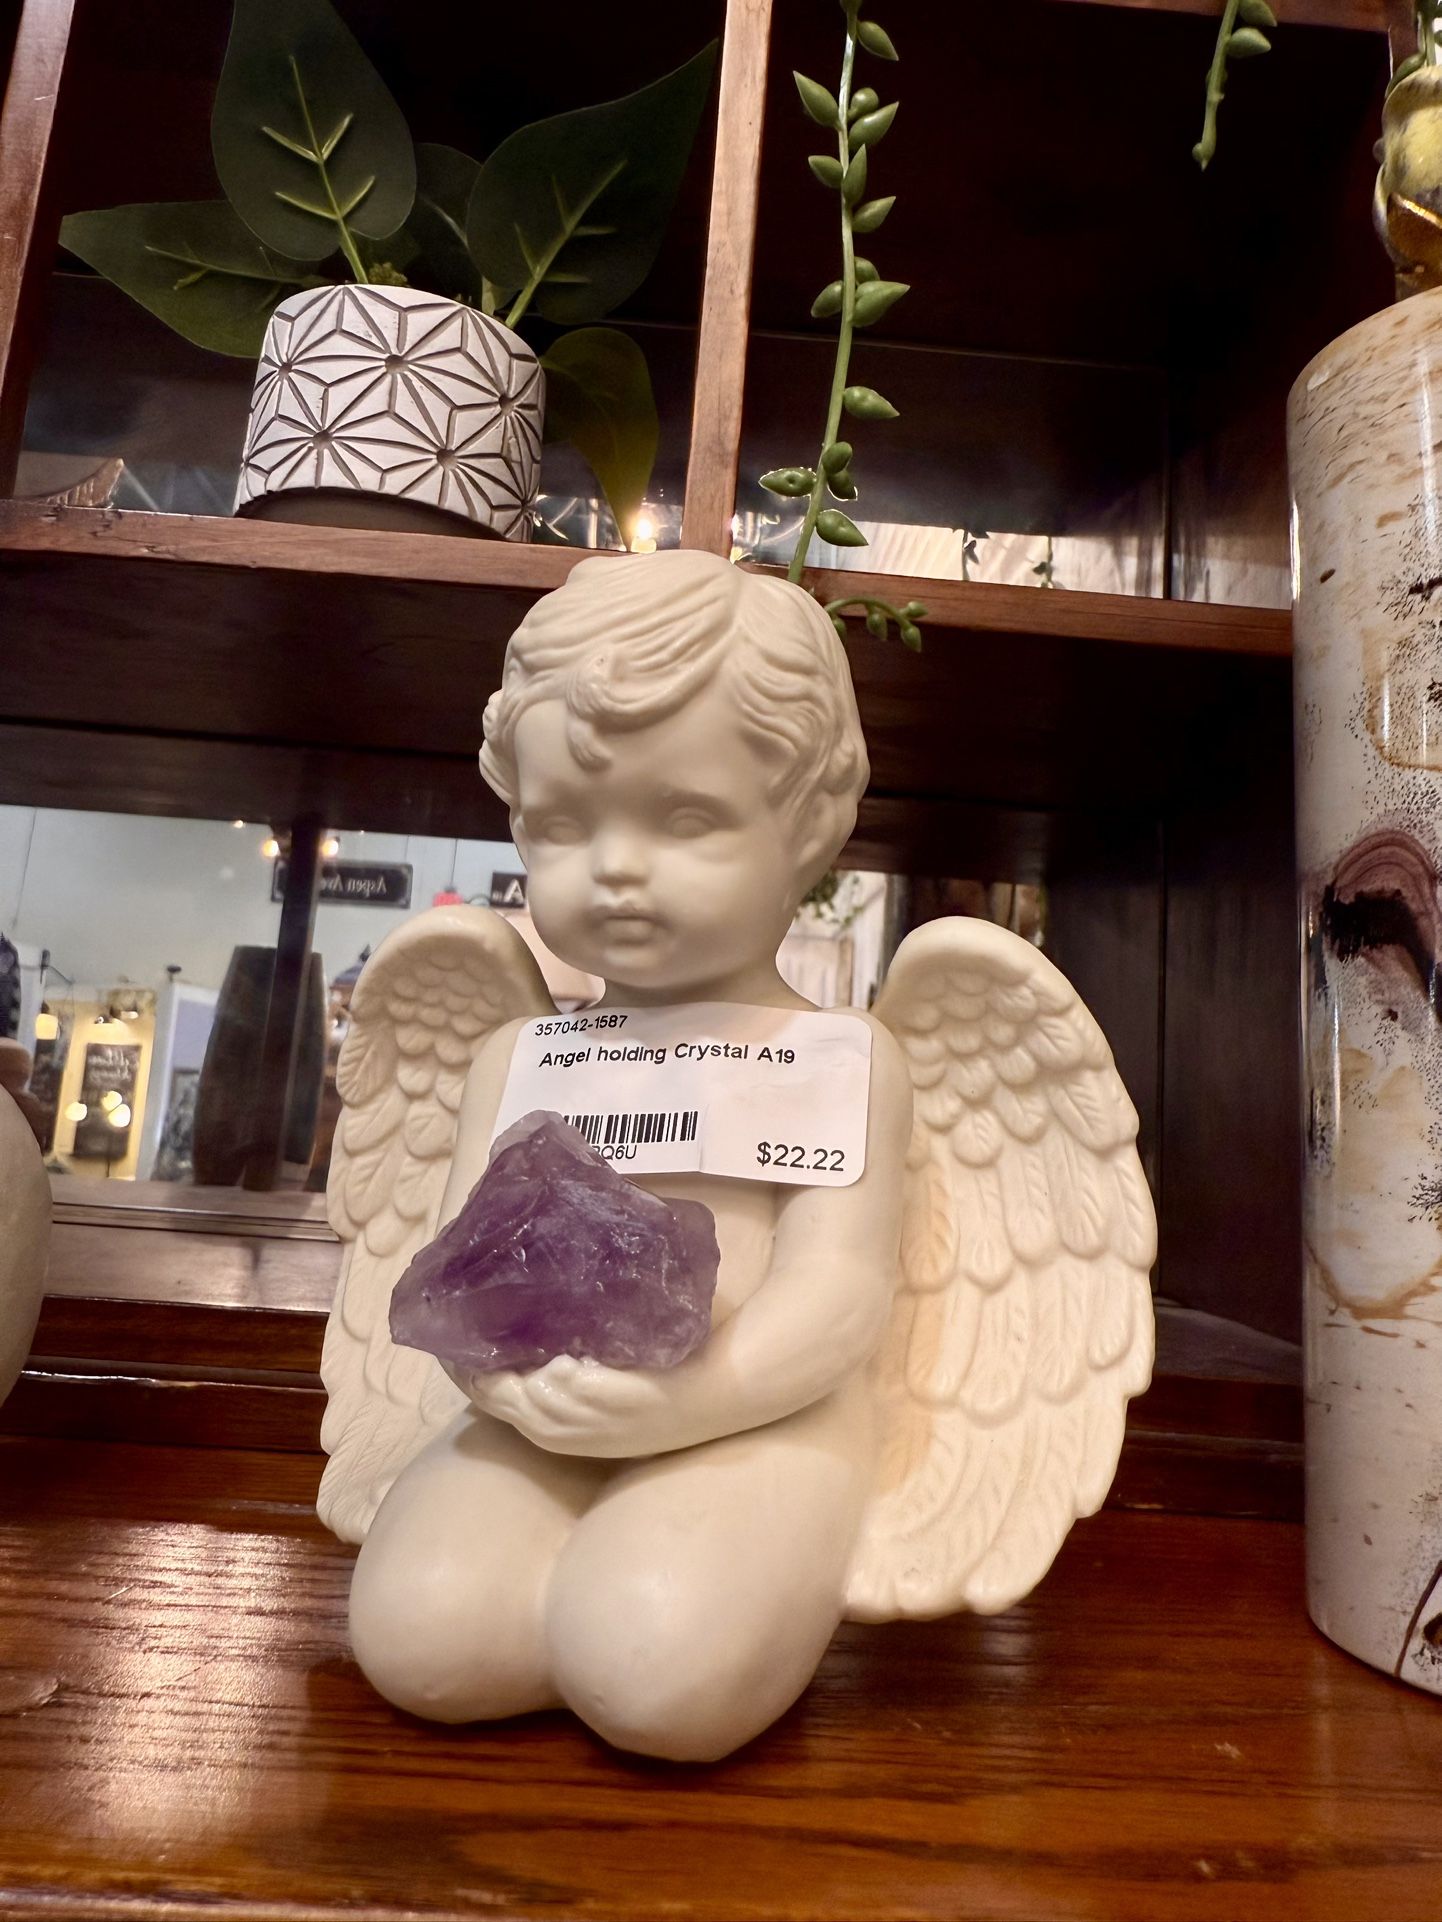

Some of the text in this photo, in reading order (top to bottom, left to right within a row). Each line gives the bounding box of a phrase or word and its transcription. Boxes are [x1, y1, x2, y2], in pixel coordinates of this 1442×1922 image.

[534, 1014, 628, 1037] 357042-1587
[538, 1042, 796, 1068] Angel holding Crystal A19
[756, 1141, 846, 1172] $22.22
